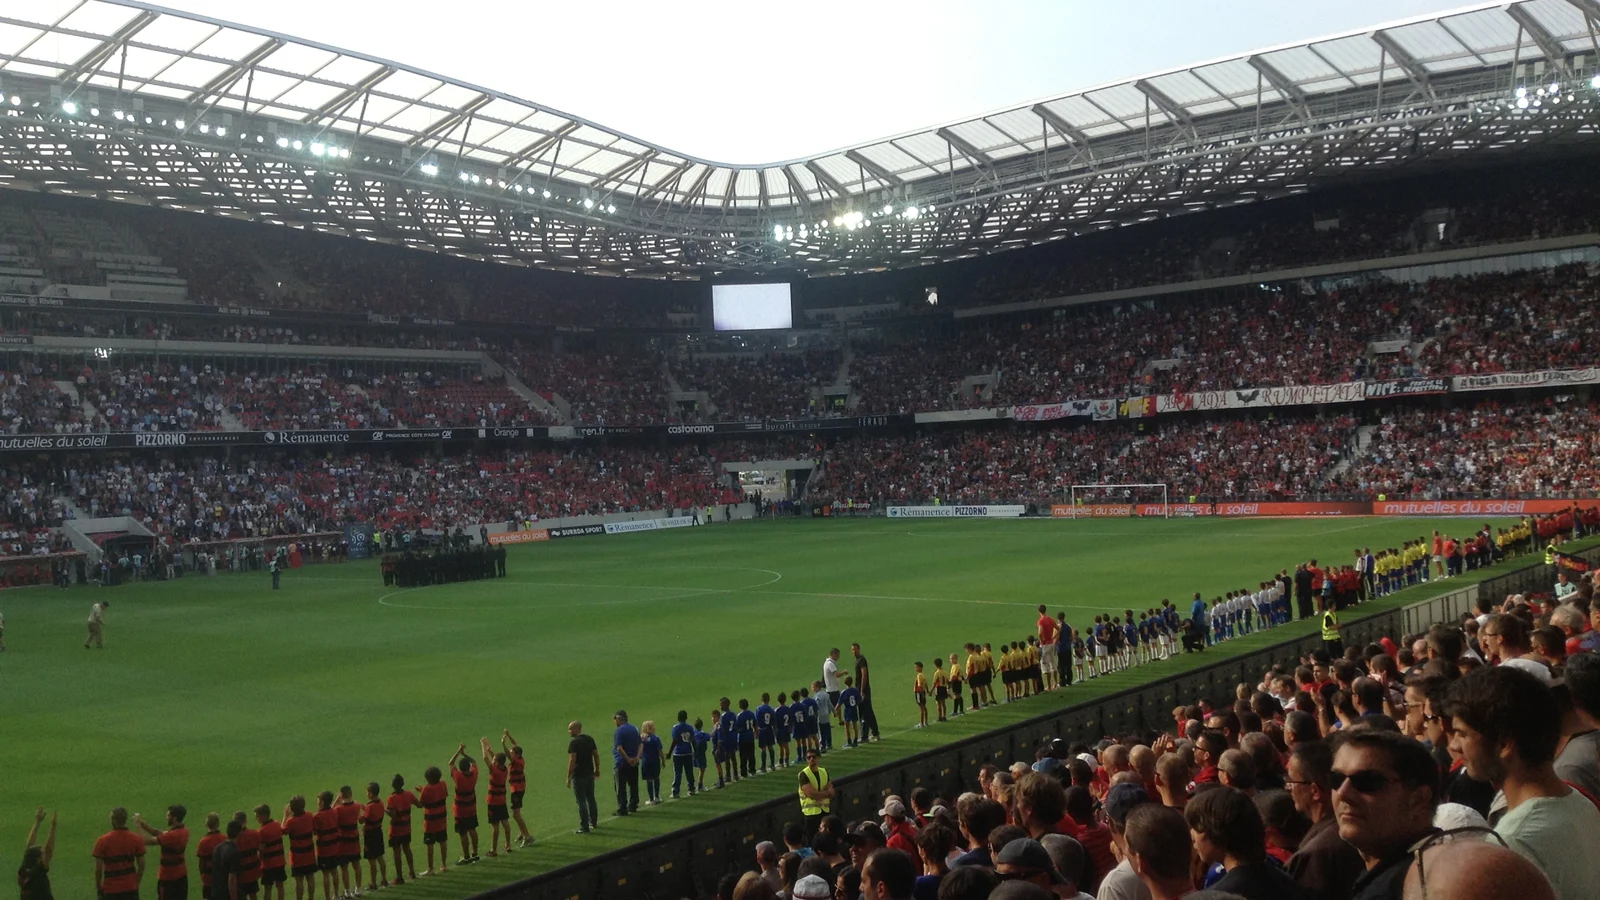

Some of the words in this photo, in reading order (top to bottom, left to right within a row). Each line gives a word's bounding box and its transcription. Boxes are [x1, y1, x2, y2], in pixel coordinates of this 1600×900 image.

[1262, 382, 1363, 406] RUMPETATA
[494, 428, 519, 438] Orange
[668, 424, 715, 434] castorama
[56, 436, 74, 448] du
[77, 435, 108, 447] soleil
[135, 433, 186, 446] PIZZORNO
[279, 432, 350, 444] Rémanence
[900, 507, 951, 517] Rémanence
[954, 506, 988, 516] PIZZORNO
[1095, 506, 1108, 515] du
[1109, 506, 1131, 515] soleil
[1226, 503, 1259, 515] soleil
[1385, 502, 1456, 514] mutuelles
[1459, 502, 1481, 513] du
[1485, 501, 1525, 513] soleil
[614, 521, 654, 532] Rémanence
[849, 695, 856, 707] 6
[808, 705, 815, 716] 4
[764, 713, 771, 725] 9
[783, 714, 789, 726] 2
